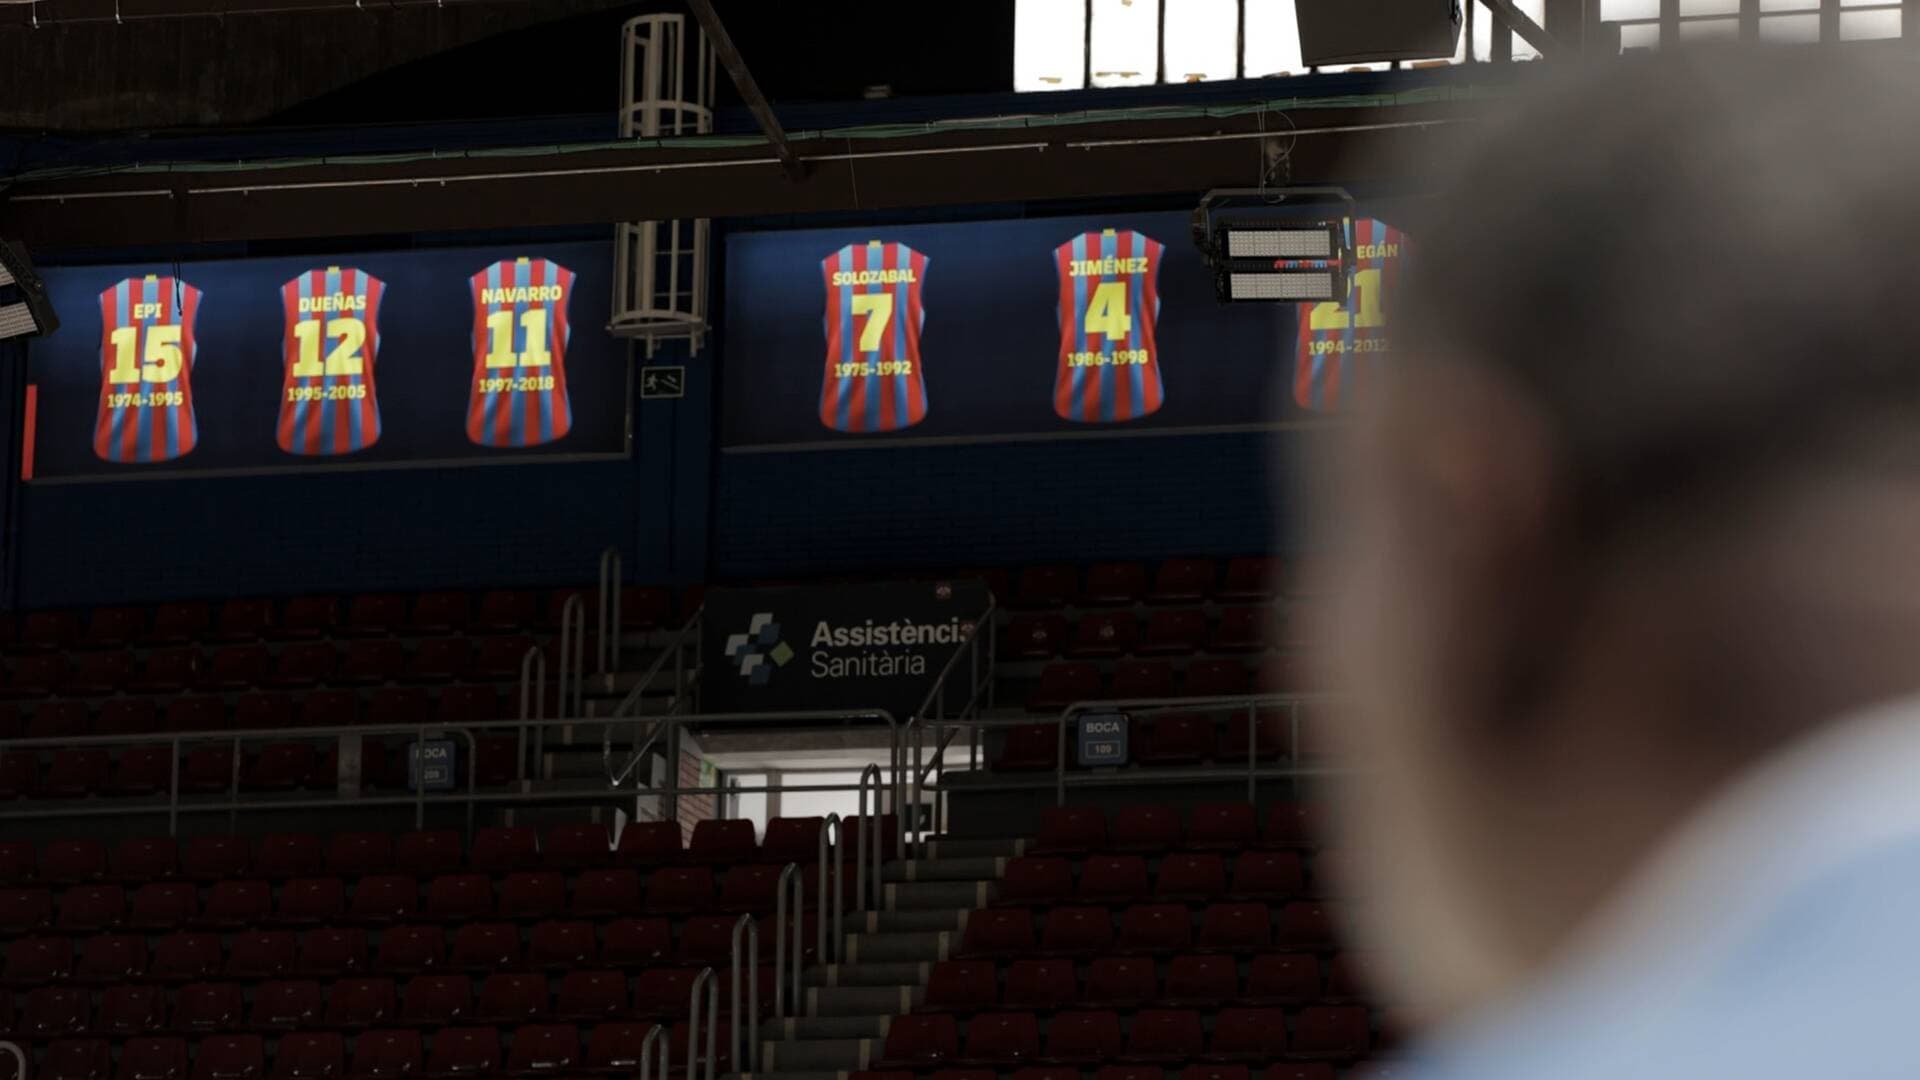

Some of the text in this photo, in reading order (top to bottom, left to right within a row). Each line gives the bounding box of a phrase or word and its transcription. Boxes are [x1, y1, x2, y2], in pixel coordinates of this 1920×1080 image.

[1356, 240, 1399, 260] EGÁN
[1069, 255, 1149, 277] JIMÉNEZ
[832, 269, 917, 286] SOLOZABAL
[298, 291, 367, 313] DUEÑAS
[481, 285, 563, 305] NAVARRO
[134, 303, 163, 320] EPI
[1084, 281, 1132, 341] 4
[851, 292, 893, 353] 7
[293, 317, 367, 378] 12
[485, 307, 552, 369] 11
[109, 324, 184, 385] 15
[1066, 348, 1148, 368] 1986-1998
[834, 360, 913, 378] 1975-1992
[287, 384, 367, 403] 1995-2005
[479, 375, 555, 394] 1997-2018
[106, 391, 184, 409] 1974-1995
[810, 616, 968, 648] Assistènci
[810, 649, 927, 679] Sanitària
[1086, 721, 1120, 733] BOCA
